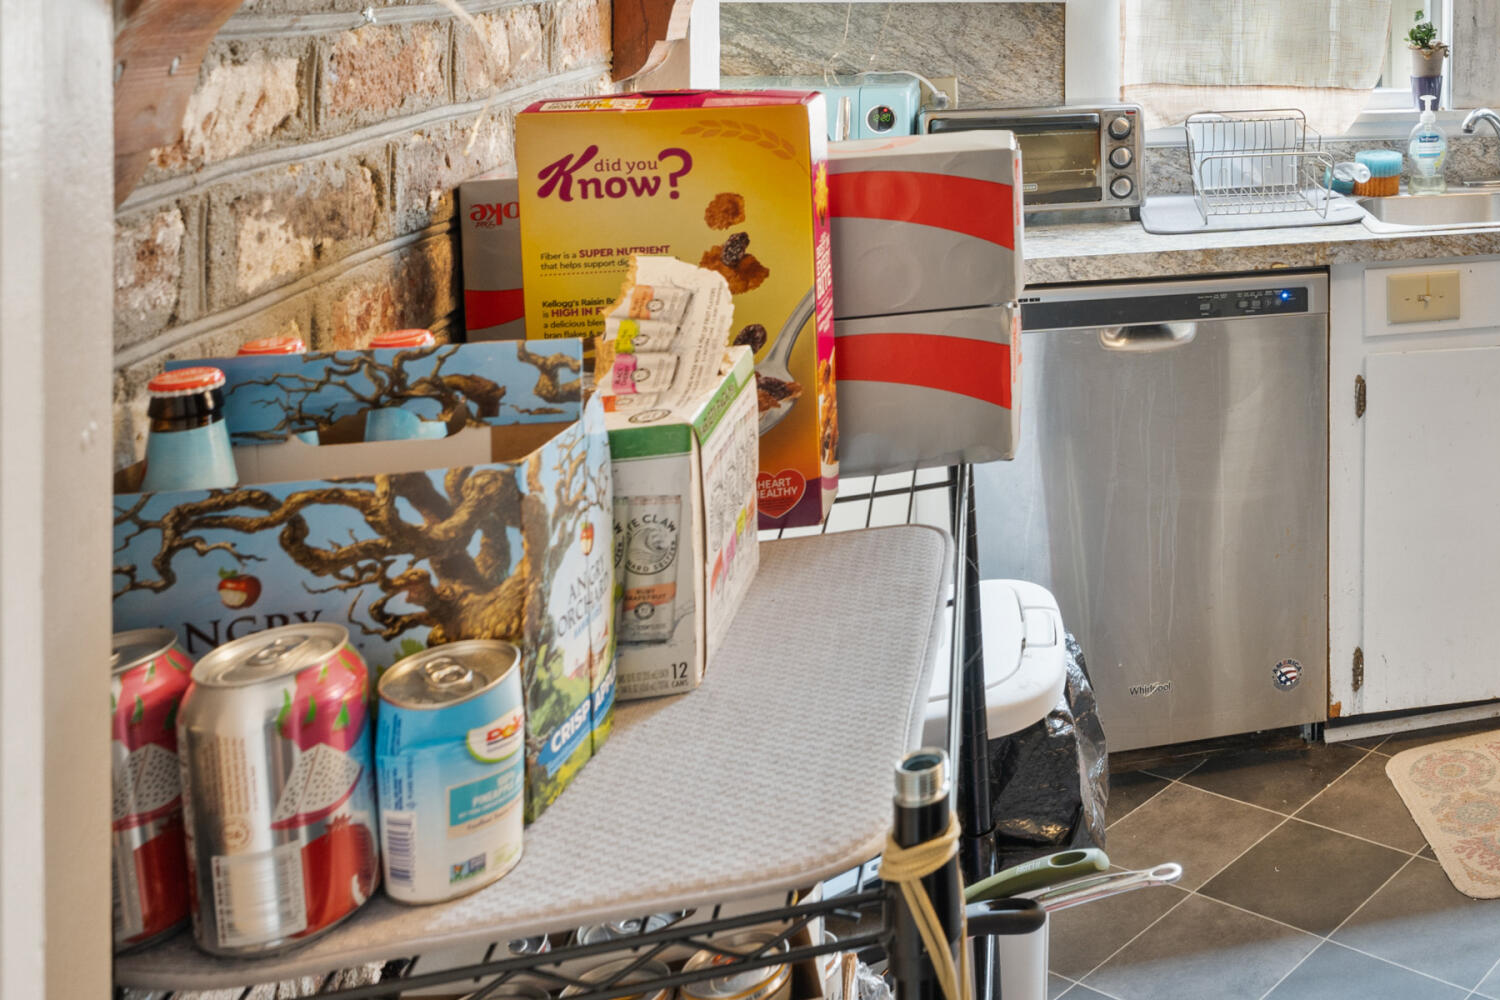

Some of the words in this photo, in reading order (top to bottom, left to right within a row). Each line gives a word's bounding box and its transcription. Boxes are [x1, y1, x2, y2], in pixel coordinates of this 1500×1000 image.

[594, 158, 622, 172] did
[625, 160, 658, 175] you
[470, 202, 520, 226] oke
[540, 252, 561, 261] Fiber
[563, 251, 570, 259] is
[578, 248, 614, 259] SUPER
[616, 245, 671, 256] NUTRIENT
[540, 262, 558, 270] that
[560, 259, 582, 269] helps
[583, 258, 616, 269] support
[542, 298, 579, 308] Kellogg's
[581, 298, 605, 307] Raisin
[542, 310, 549, 318] is
[551, 308, 579, 318] HIGH
[581, 307, 593, 316] IN
[550, 320, 586, 329] delicious
[563, 330, 588, 338] flakes
[758, 476, 792, 489] HEART
[757, 486, 798, 499] EALTHY
[642, 513, 676, 532] CLAW
[671, 662, 688, 680] 12
[671, 679, 689, 689] CANS
[550, 699, 591, 753] CRISP
